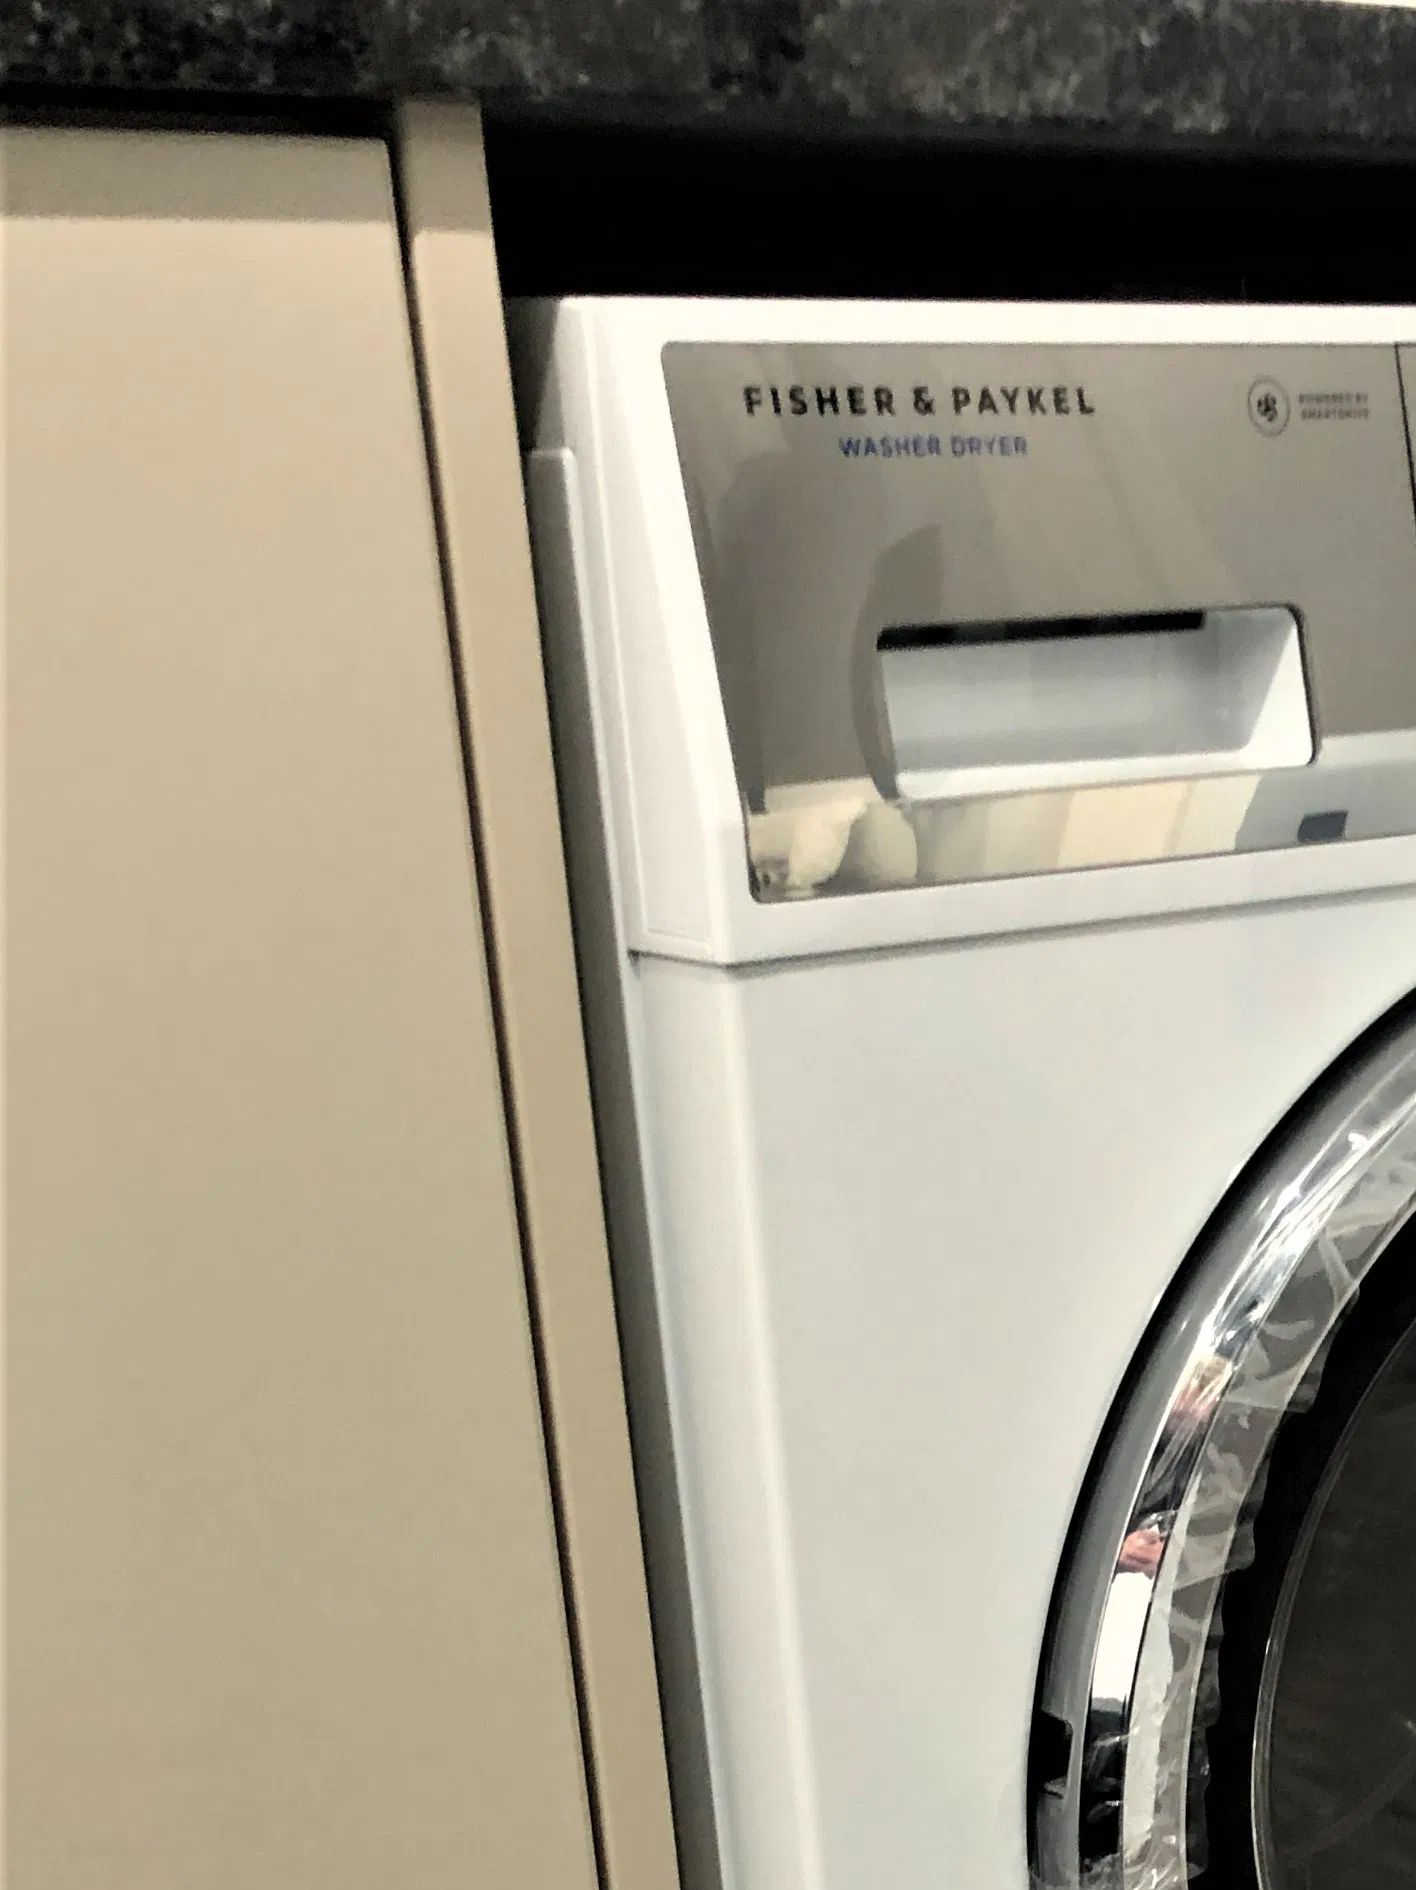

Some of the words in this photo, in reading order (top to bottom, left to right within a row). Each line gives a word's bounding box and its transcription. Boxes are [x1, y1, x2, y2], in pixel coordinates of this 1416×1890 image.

[742, 383, 895, 417] FISHER
[912, 383, 936, 417] &
[952, 384, 1095, 417] PAYKEL
[838, 435, 942, 458] WASHER
[951, 435, 1028, 458] DRYER
